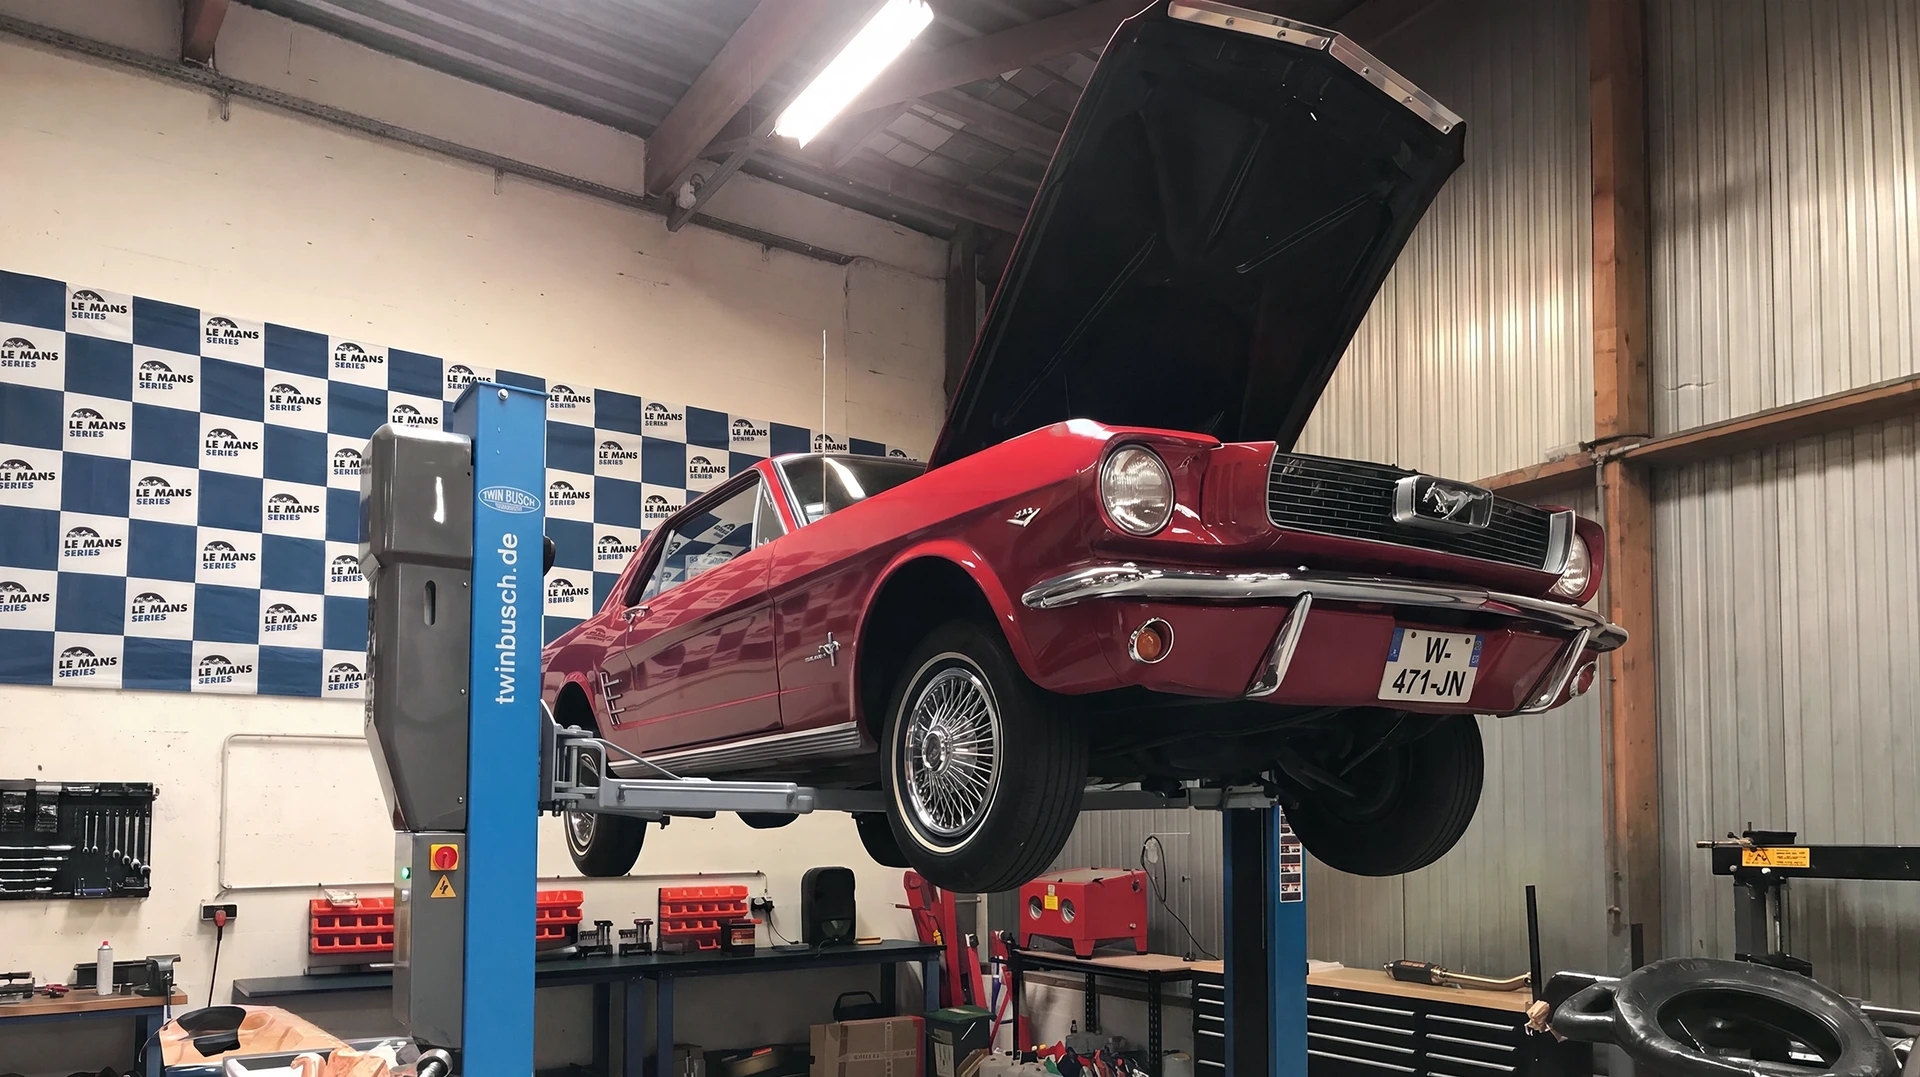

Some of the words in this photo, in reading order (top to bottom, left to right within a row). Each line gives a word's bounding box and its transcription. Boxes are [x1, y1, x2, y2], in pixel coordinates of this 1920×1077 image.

[72, 302, 84, 310] LE
[90, 303, 127, 314] MANS
[72, 311, 106, 320] SERIES
[206, 328, 218, 336] LE
[224, 330, 259, 339] MANS
[207, 337, 238, 345] SERIES
[1, 350, 14, 359] LE
[20, 351, 58, 360] MANS
[335, 353, 346, 361] LE
[351, 354, 383, 363] MANS
[1, 360, 36, 368] SERIES
[139, 372, 152, 381] LE
[157, 374, 194, 383] MANS
[140, 382, 173, 390] SERIES
[270, 395, 282, 403] LE
[287, 396, 321, 405] MANS
[550, 394, 559, 402] LE
[563, 395, 590, 403] MANS
[408, 416, 438, 424] MANS
[645, 412, 654, 420] LE
[69, 420, 83, 429] LE
[88, 421, 126, 430] MANS
[206, 440, 218, 448] LE
[224, 441, 258, 450] MANS
[334, 460, 345, 468] LE
[0, 472, 11, 481] LE
[16, 472, 55, 481] MANS
[136, 489, 150, 497] LE
[154, 489, 192, 497] MANS
[483, 490, 503, 501] TWIN
[506, 490, 535, 506] BUSCH
[268, 505, 280, 513] LE
[64, 540, 78, 548] LE
[83, 539, 122, 548] MANS
[610, 545, 637, 553] MANS
[203, 553, 216, 561] LE
[220, 553, 256, 561] MANS
[332, 567, 343, 575] LE
[562, 588, 589, 596] MANS
[0, 595, 4, 604] E
[9, 594, 50, 603] MANS
[132, 606, 145, 614] LE
[150, 604, 187, 613] MANS
[132, 614, 166, 622] SERIES
[265, 616, 277, 624] LE
[282, 614, 317, 623] MANS
[494, 533, 518, 704] twinbusch.de
[265, 624, 297, 632] SERIES
[1425, 637, 1451, 663] W-
[59, 660, 73, 669] LE
[78, 657, 117, 668] MANS
[59, 668, 95, 677] SERIES
[198, 668, 211, 676] LE
[216, 665, 252, 675] MANS
[199, 676, 232, 684] SERIES
[328, 675, 340, 683] LE
[1392, 669, 1466, 696] 471-JN
[328, 682, 359, 690] SERIES
